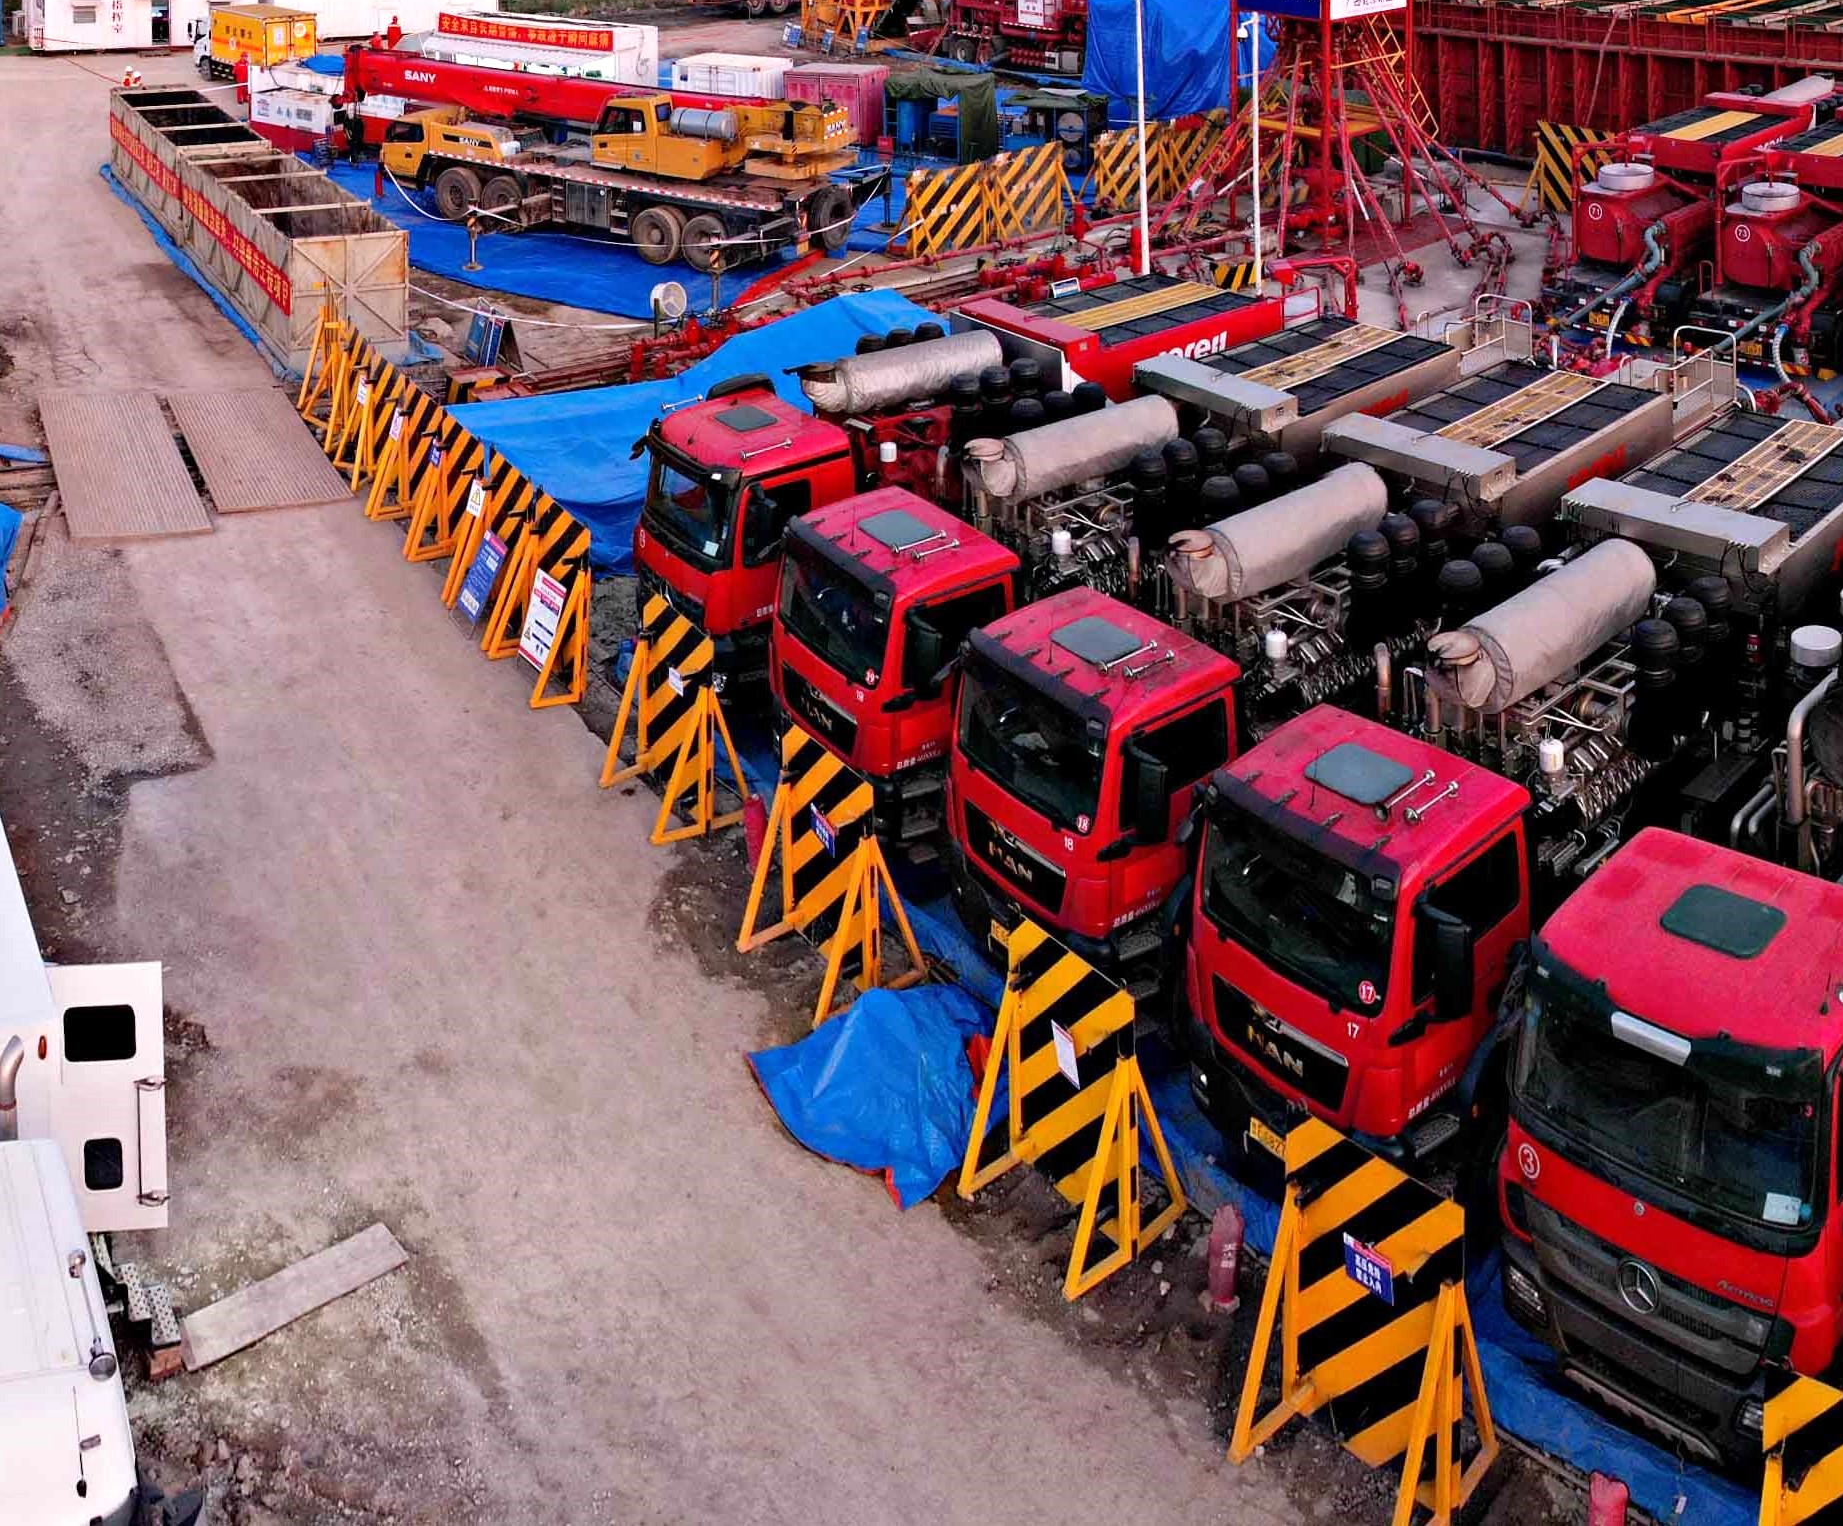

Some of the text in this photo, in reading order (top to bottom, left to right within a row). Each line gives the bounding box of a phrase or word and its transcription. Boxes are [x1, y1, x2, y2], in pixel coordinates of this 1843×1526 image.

[404, 69, 437, 85] SANY
[459, 137, 480, 147] SANY
[1064, 836, 1074, 851] 18
[989, 842, 1032, 882] MAN
[1347, 1021, 1359, 1039] 17
[1247, 1025, 1303, 1077] MAN
